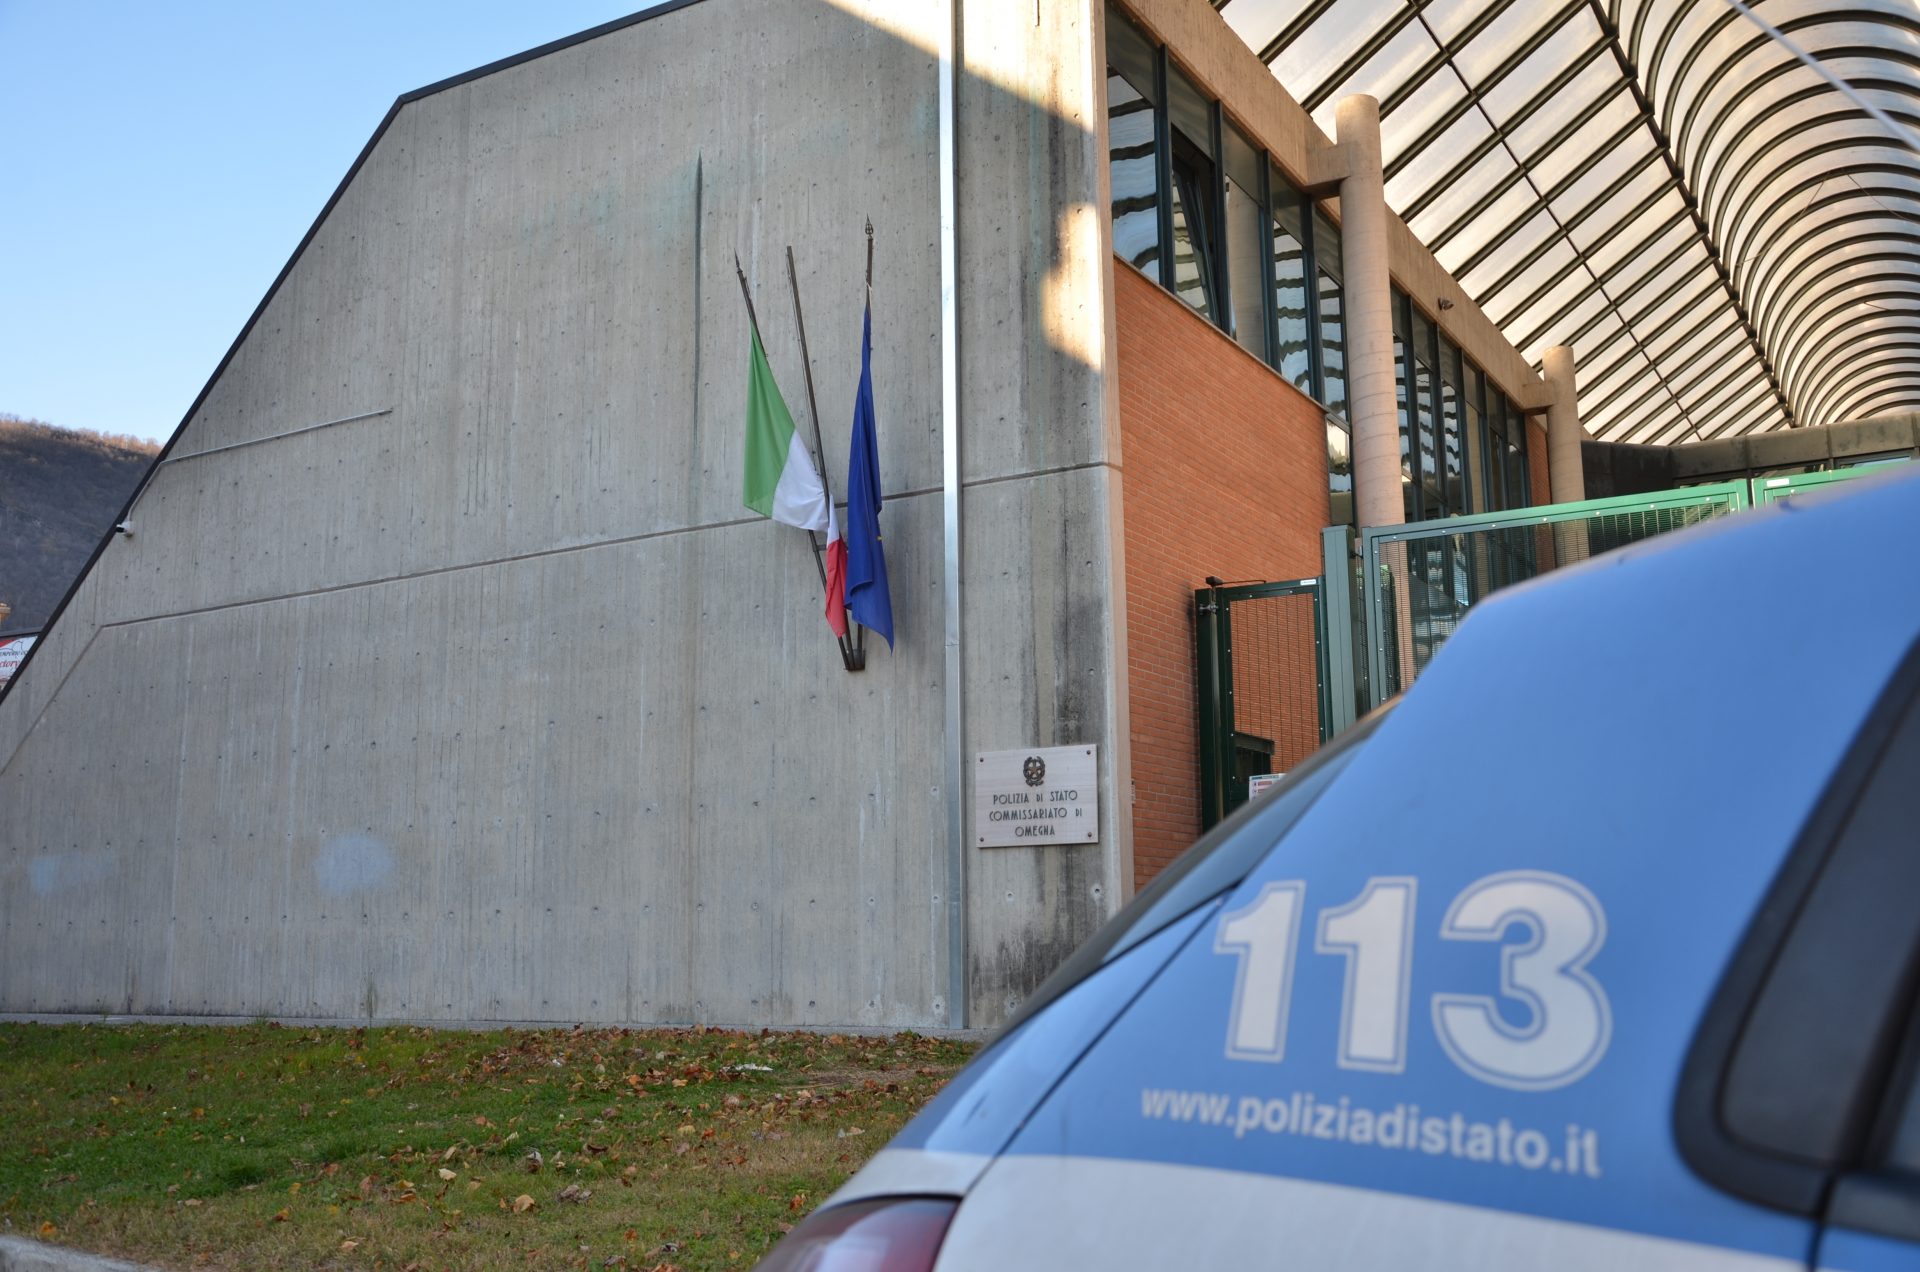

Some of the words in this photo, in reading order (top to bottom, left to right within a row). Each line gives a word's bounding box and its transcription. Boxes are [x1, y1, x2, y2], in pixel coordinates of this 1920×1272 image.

[993, 793, 1029, 805] POLIZIA
[1036, 793, 1043, 803] DI
[1050, 790, 1078, 802] STATO
[989, 807, 1068, 821] COMMISSARIATO
[1075, 807, 1082, 817] DI
[1015, 825, 1055, 837] OMEGNA
[1213, 869, 1613, 1092] 113
[1141, 1088, 1602, 1178] www.poliziadistato.it
